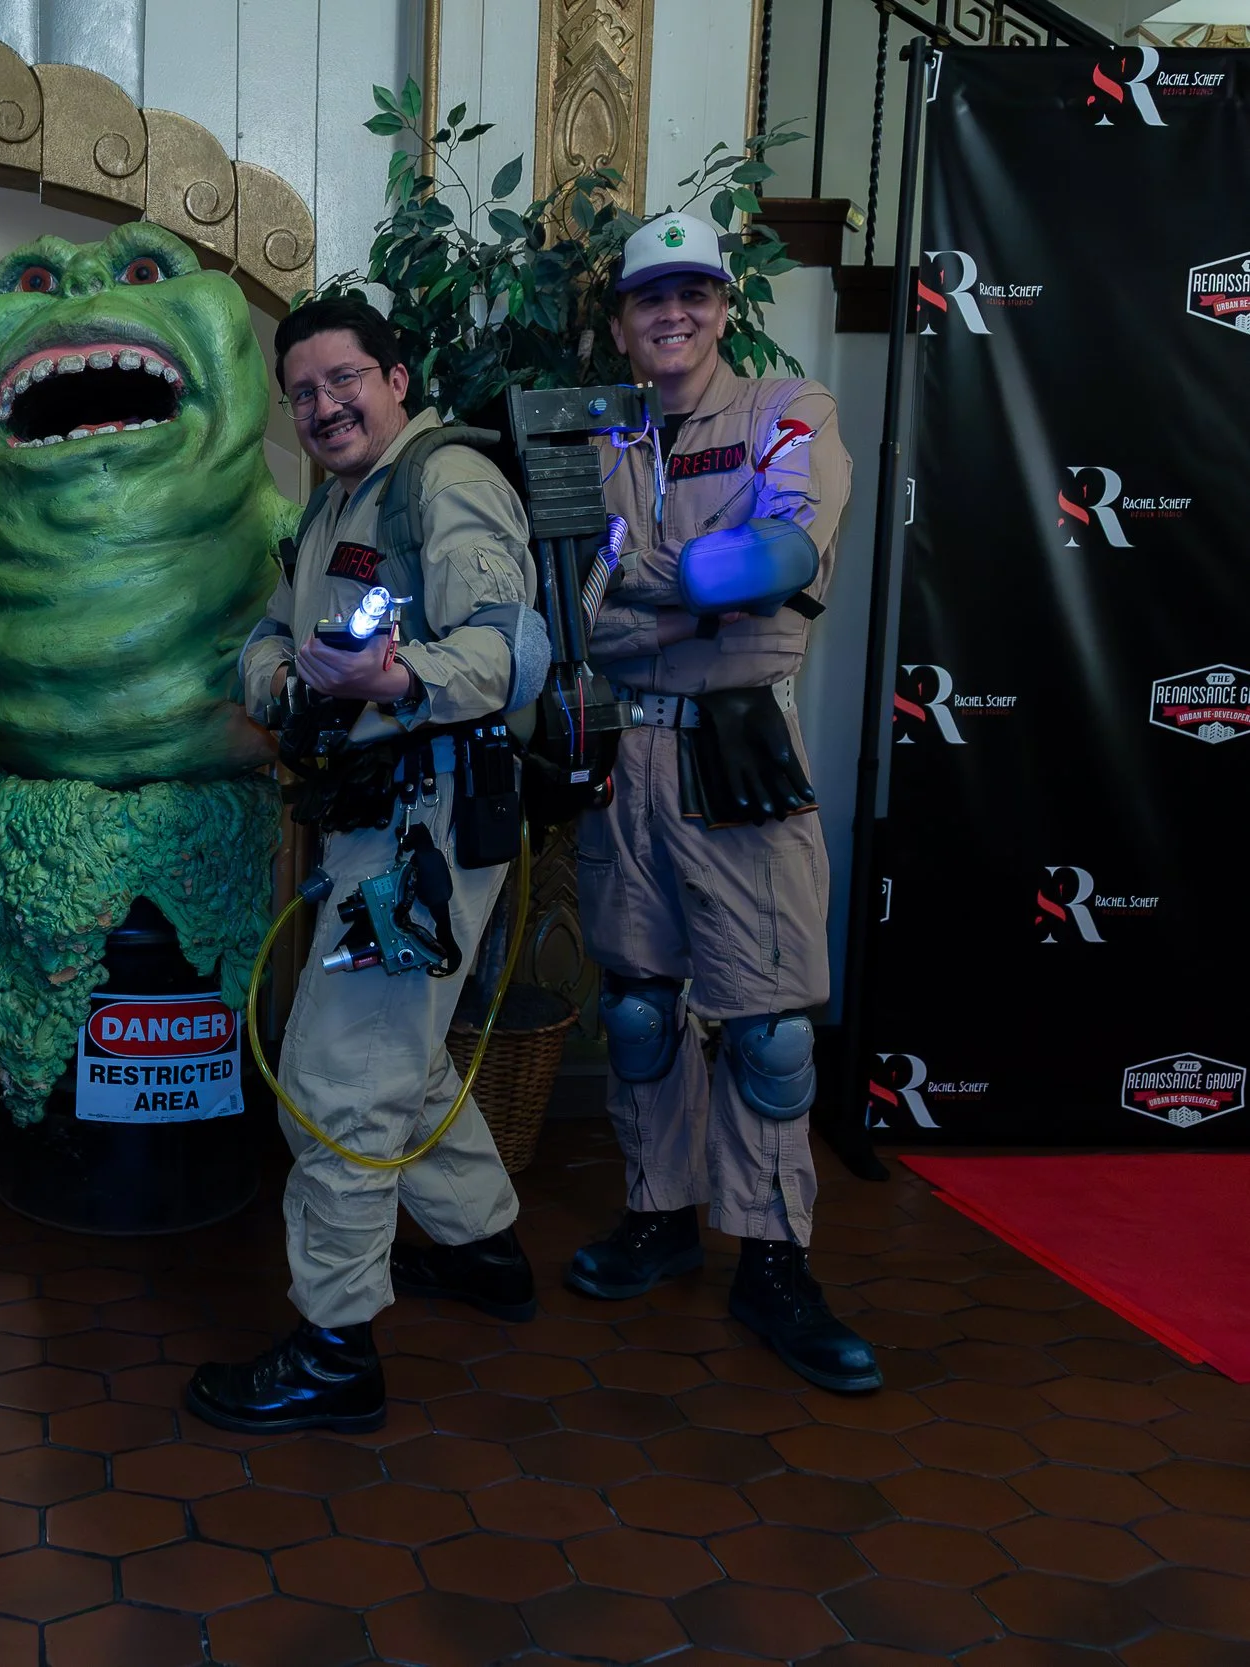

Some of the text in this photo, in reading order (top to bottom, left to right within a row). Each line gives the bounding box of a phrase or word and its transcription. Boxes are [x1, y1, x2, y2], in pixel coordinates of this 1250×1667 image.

[1157, 71, 1225, 86] RACHEL SCHEFF
[979, 282, 1043, 297] RACHEL SCHEFF
[671, 446, 744, 477] PRESTON
[1122, 496, 1192, 509] RACHEL SCHEFF
[1210, 675, 1231, 683] THE
[954, 694, 1018, 707] RACHEL SCHEFF
[1156, 685, 1237, 704] RENAISSANCE
[1179, 712, 1202, 722] URBAN
[1095, 894, 1159, 907] RACHEL SCHEFF
[101, 1013, 228, 1042] DANGER
[89, 1059, 234, 1086] RESTRICTED
[1178, 1062, 1197, 1070] THE
[927, 1081, 990, 1093] RACHEL SCHEFF
[1127, 1072, 1242, 1090] RENAISSANCE GROUP
[133, 1090, 200, 1112] AREA
[1148, 1096, 1170, 1107] URBAN
